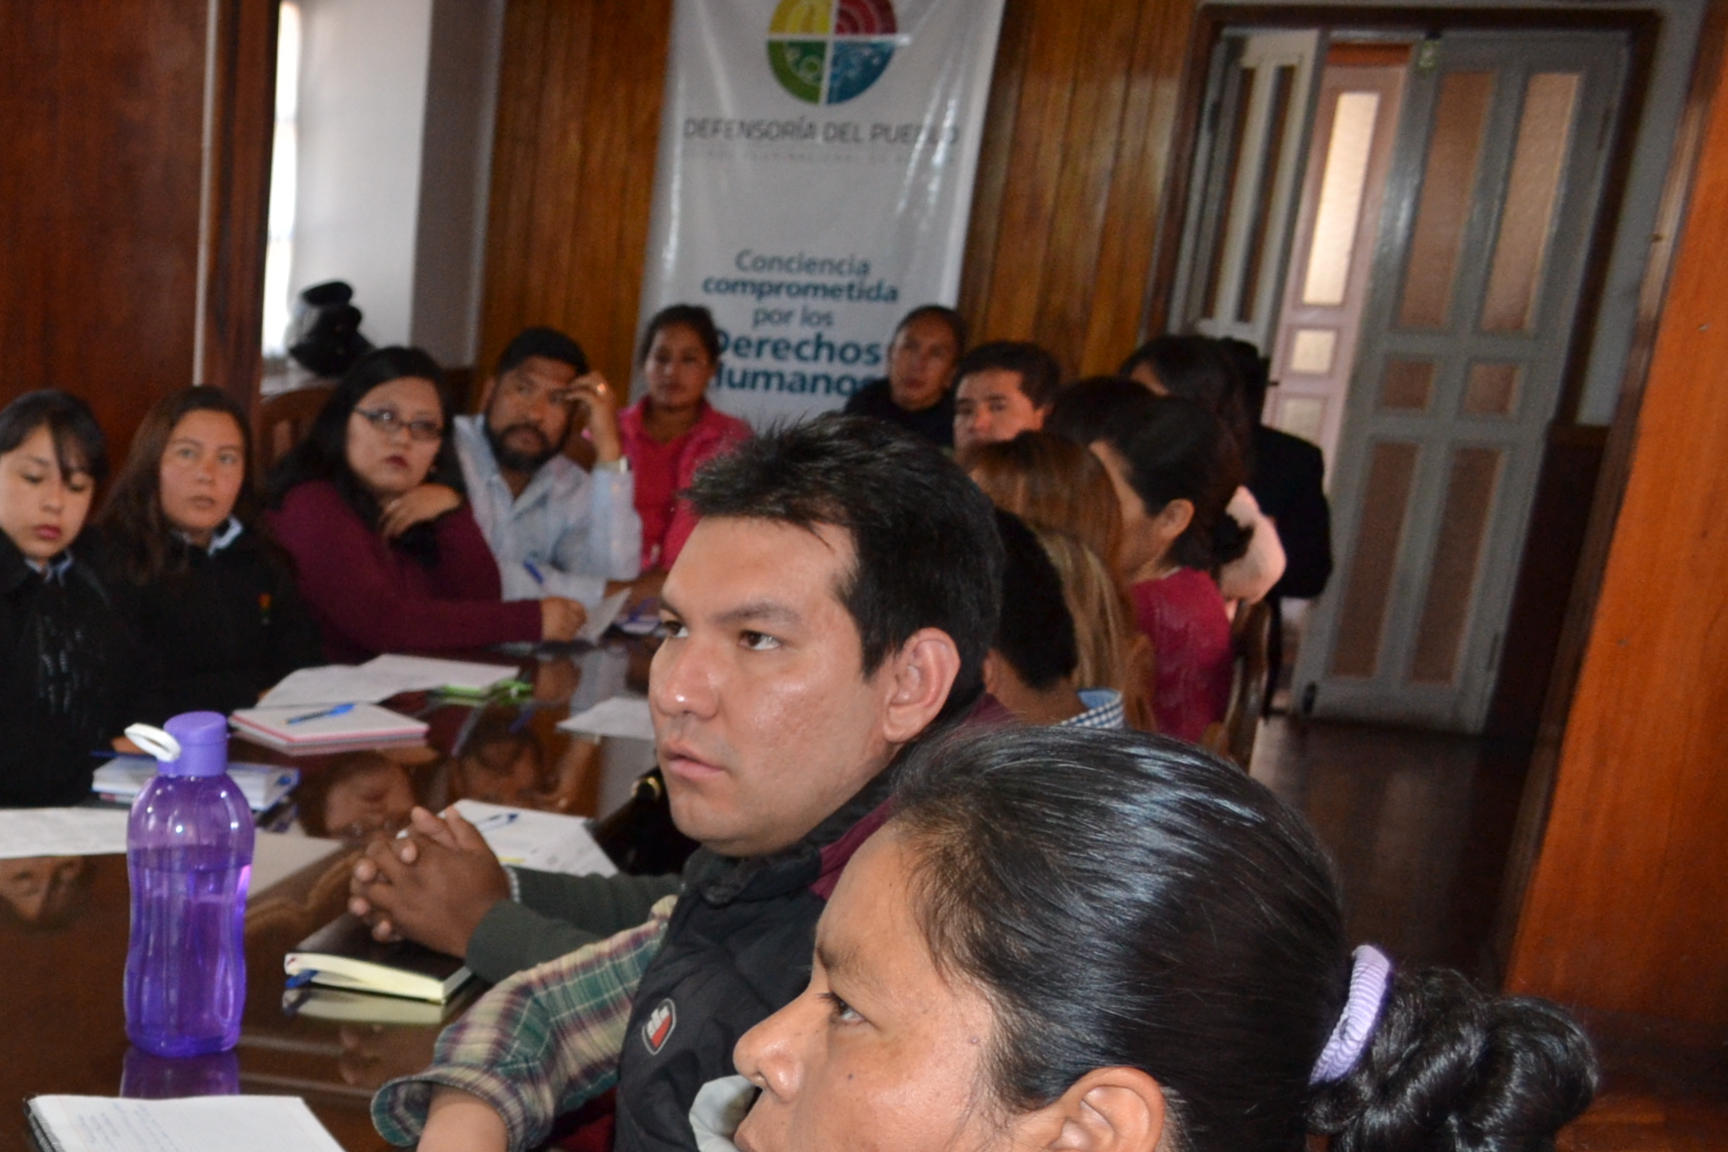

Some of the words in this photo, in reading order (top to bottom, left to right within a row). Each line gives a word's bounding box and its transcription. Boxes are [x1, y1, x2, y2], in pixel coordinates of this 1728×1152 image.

[683, 114, 817, 142] DEFENSORÍA
[823, 120, 862, 144] DEL
[735, 249, 871, 277] Conciencia
[702, 276, 900, 303] comprometida
[753, 307, 794, 328] por
[800, 305, 834, 327] los
